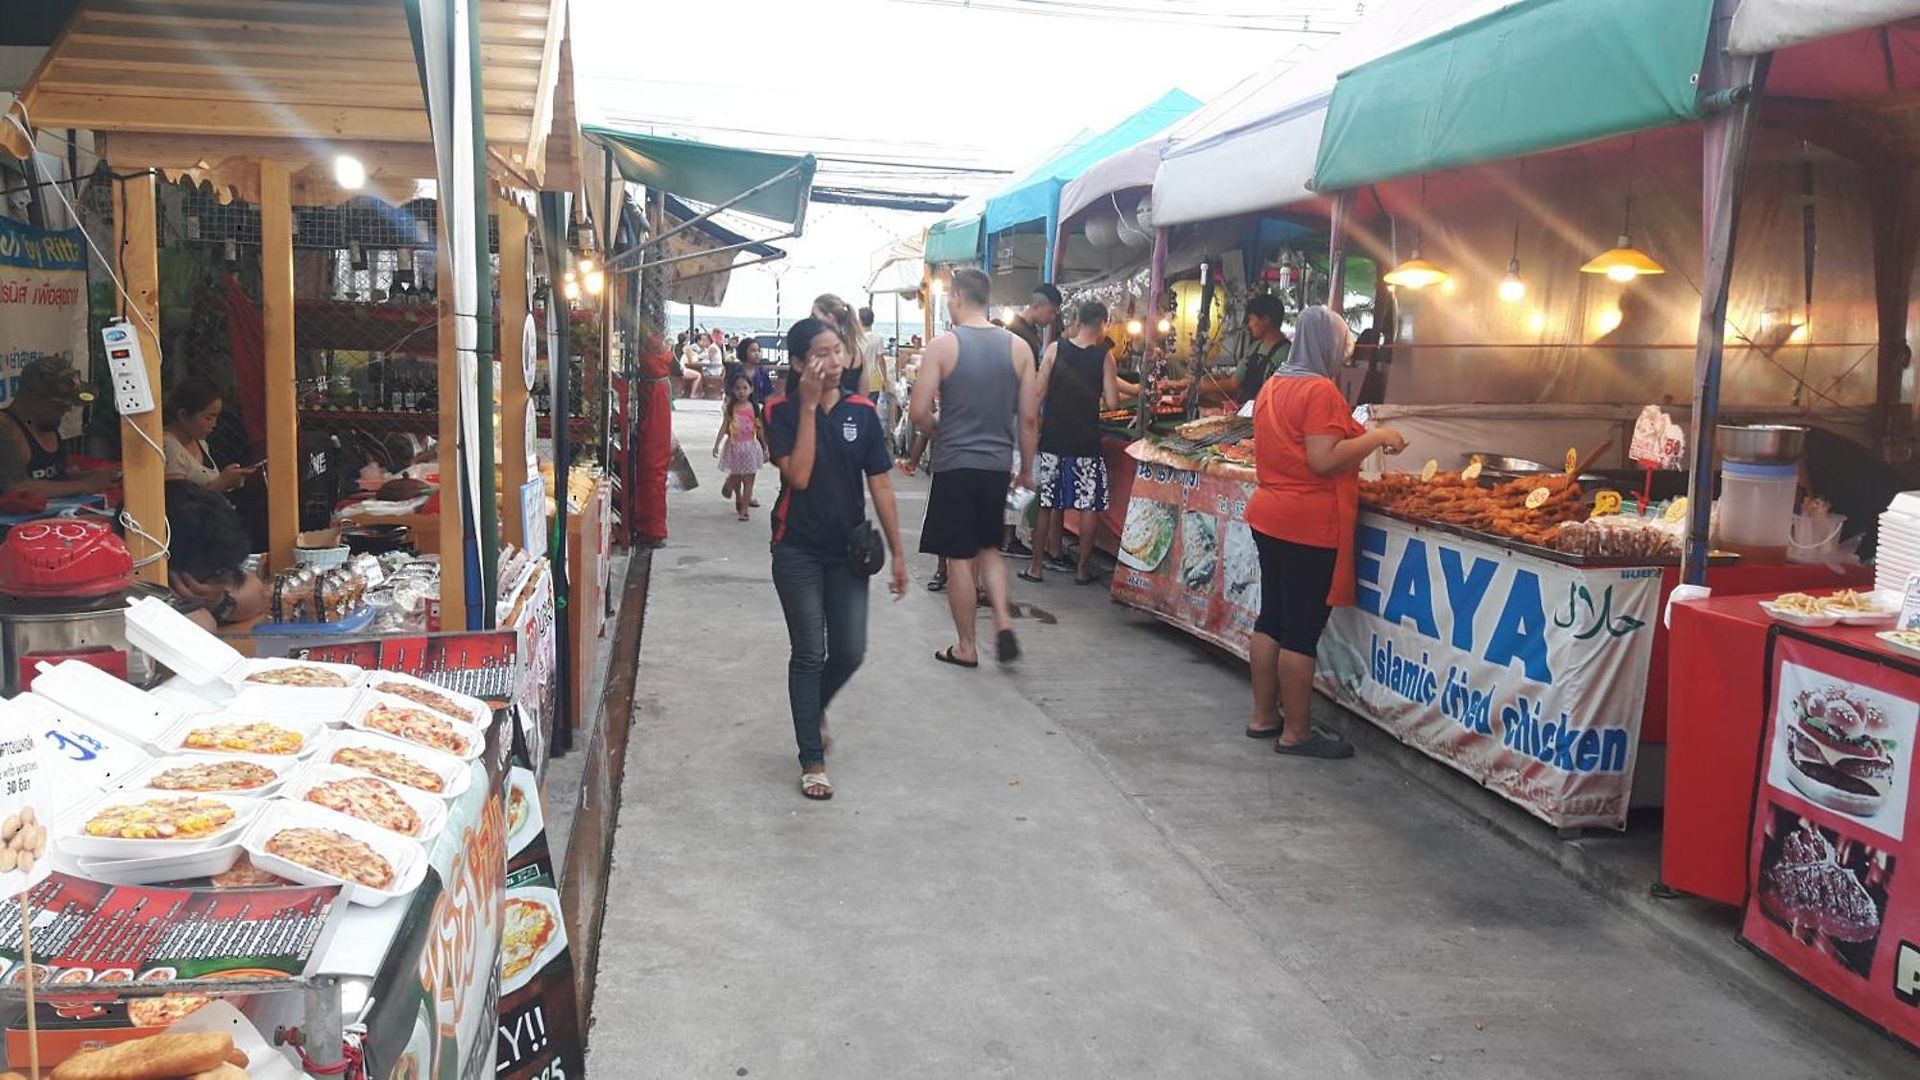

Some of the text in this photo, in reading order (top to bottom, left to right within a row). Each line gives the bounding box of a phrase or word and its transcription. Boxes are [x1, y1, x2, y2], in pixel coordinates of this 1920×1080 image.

[1553, 581, 1645, 639] حلال
[1371, 633, 1627, 772] Islamic fried chicken
